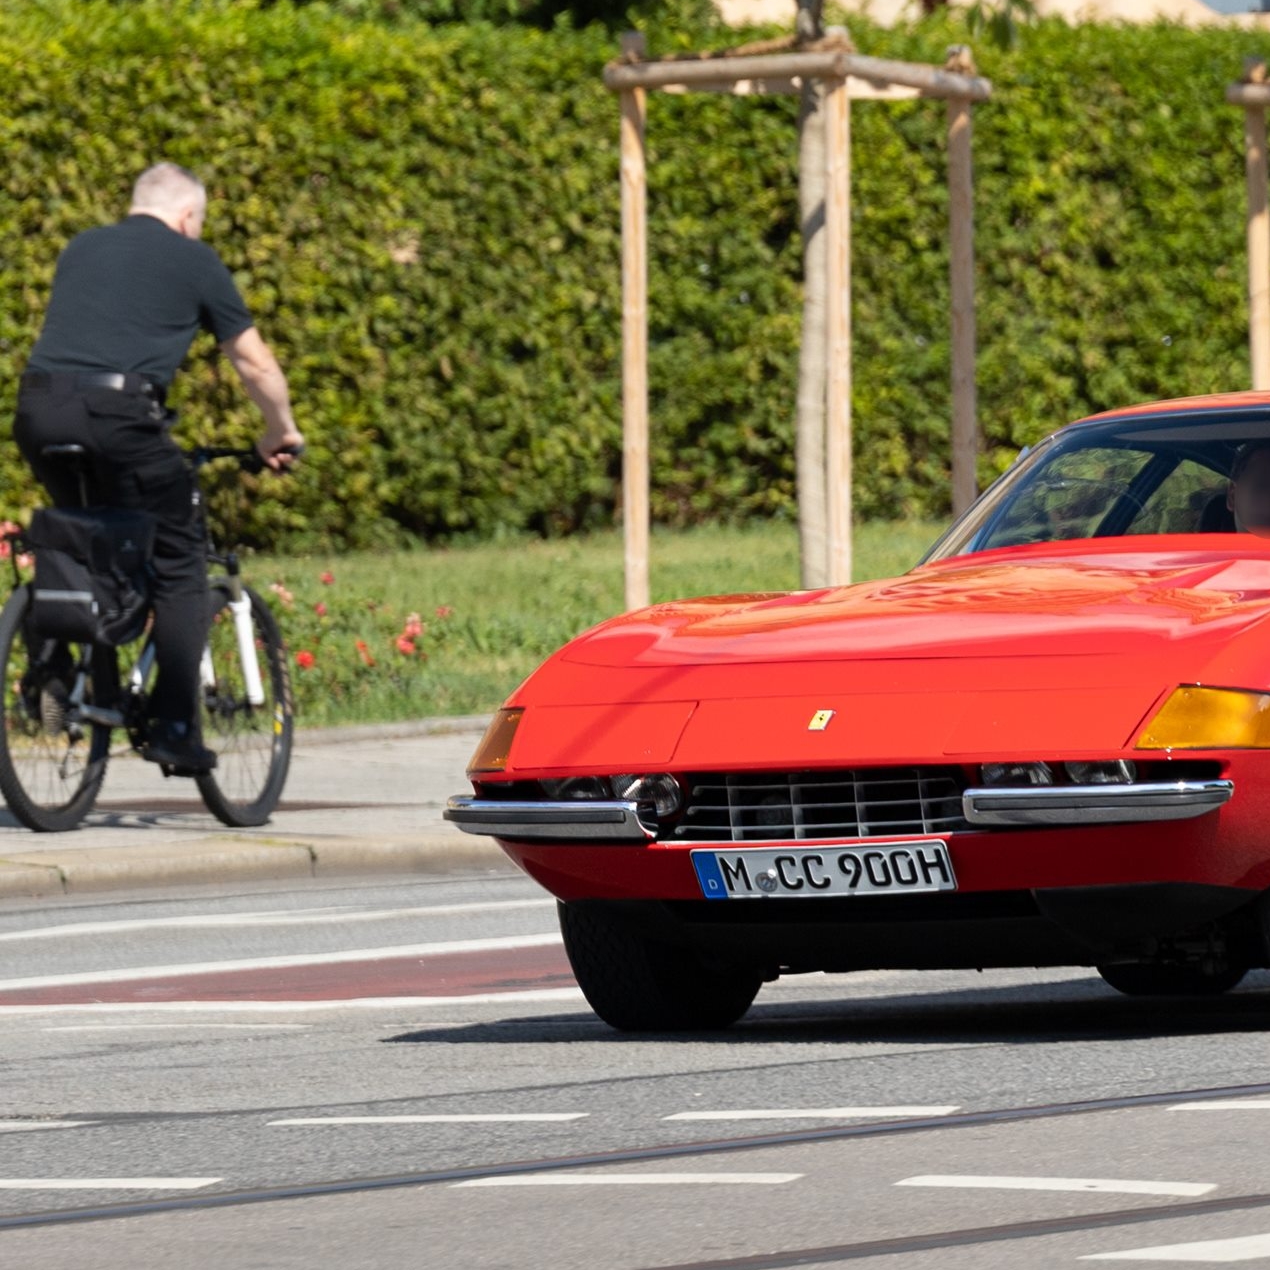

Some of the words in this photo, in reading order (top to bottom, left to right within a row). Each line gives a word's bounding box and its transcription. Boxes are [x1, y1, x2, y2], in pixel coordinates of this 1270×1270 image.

[719, 857, 752, 891] M
[775, 854, 831, 890] CC
[838, 848, 950, 888] 900H
[708, 879, 718, 890] D
